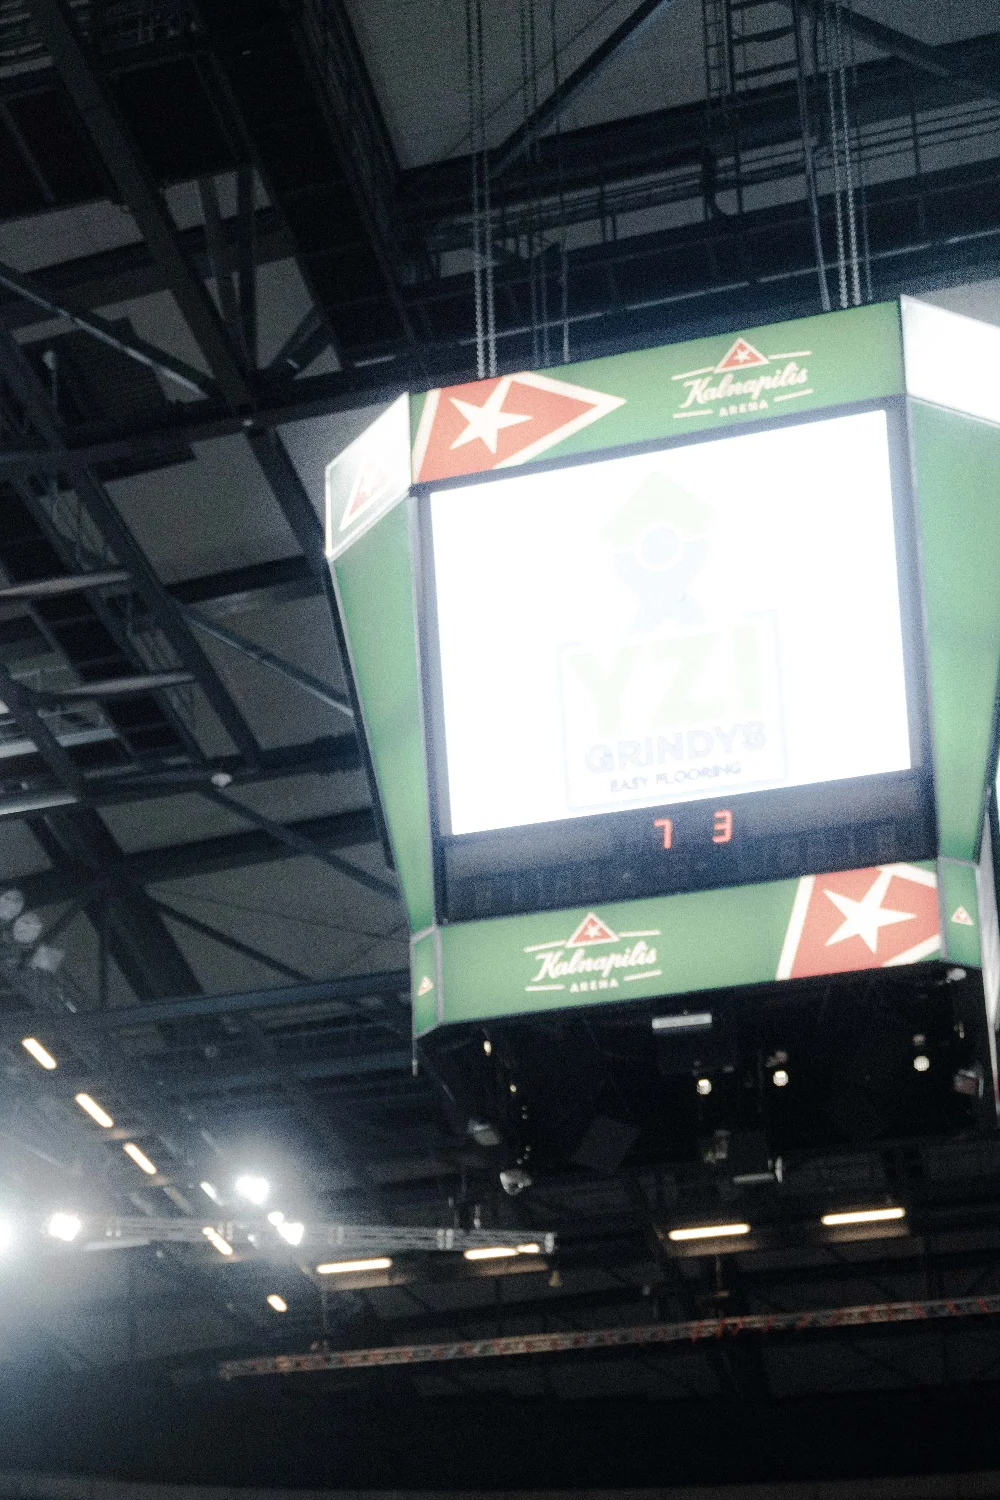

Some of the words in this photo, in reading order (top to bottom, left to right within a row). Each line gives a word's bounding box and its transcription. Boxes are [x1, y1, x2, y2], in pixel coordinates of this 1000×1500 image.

[679, 361, 809, 409] Kalnapilis
[718, 398, 769, 418] ARENA
[567, 625, 764, 738] YZI
[585, 720, 767, 775] GRINDYS
[609, 776, 649, 793] EASY
[655, 761, 742, 786] FLOORING
[711, 809, 734, 844] 3
[531, 939, 658, 983] Kalnapilis
[569, 977, 620, 994] ARENA
